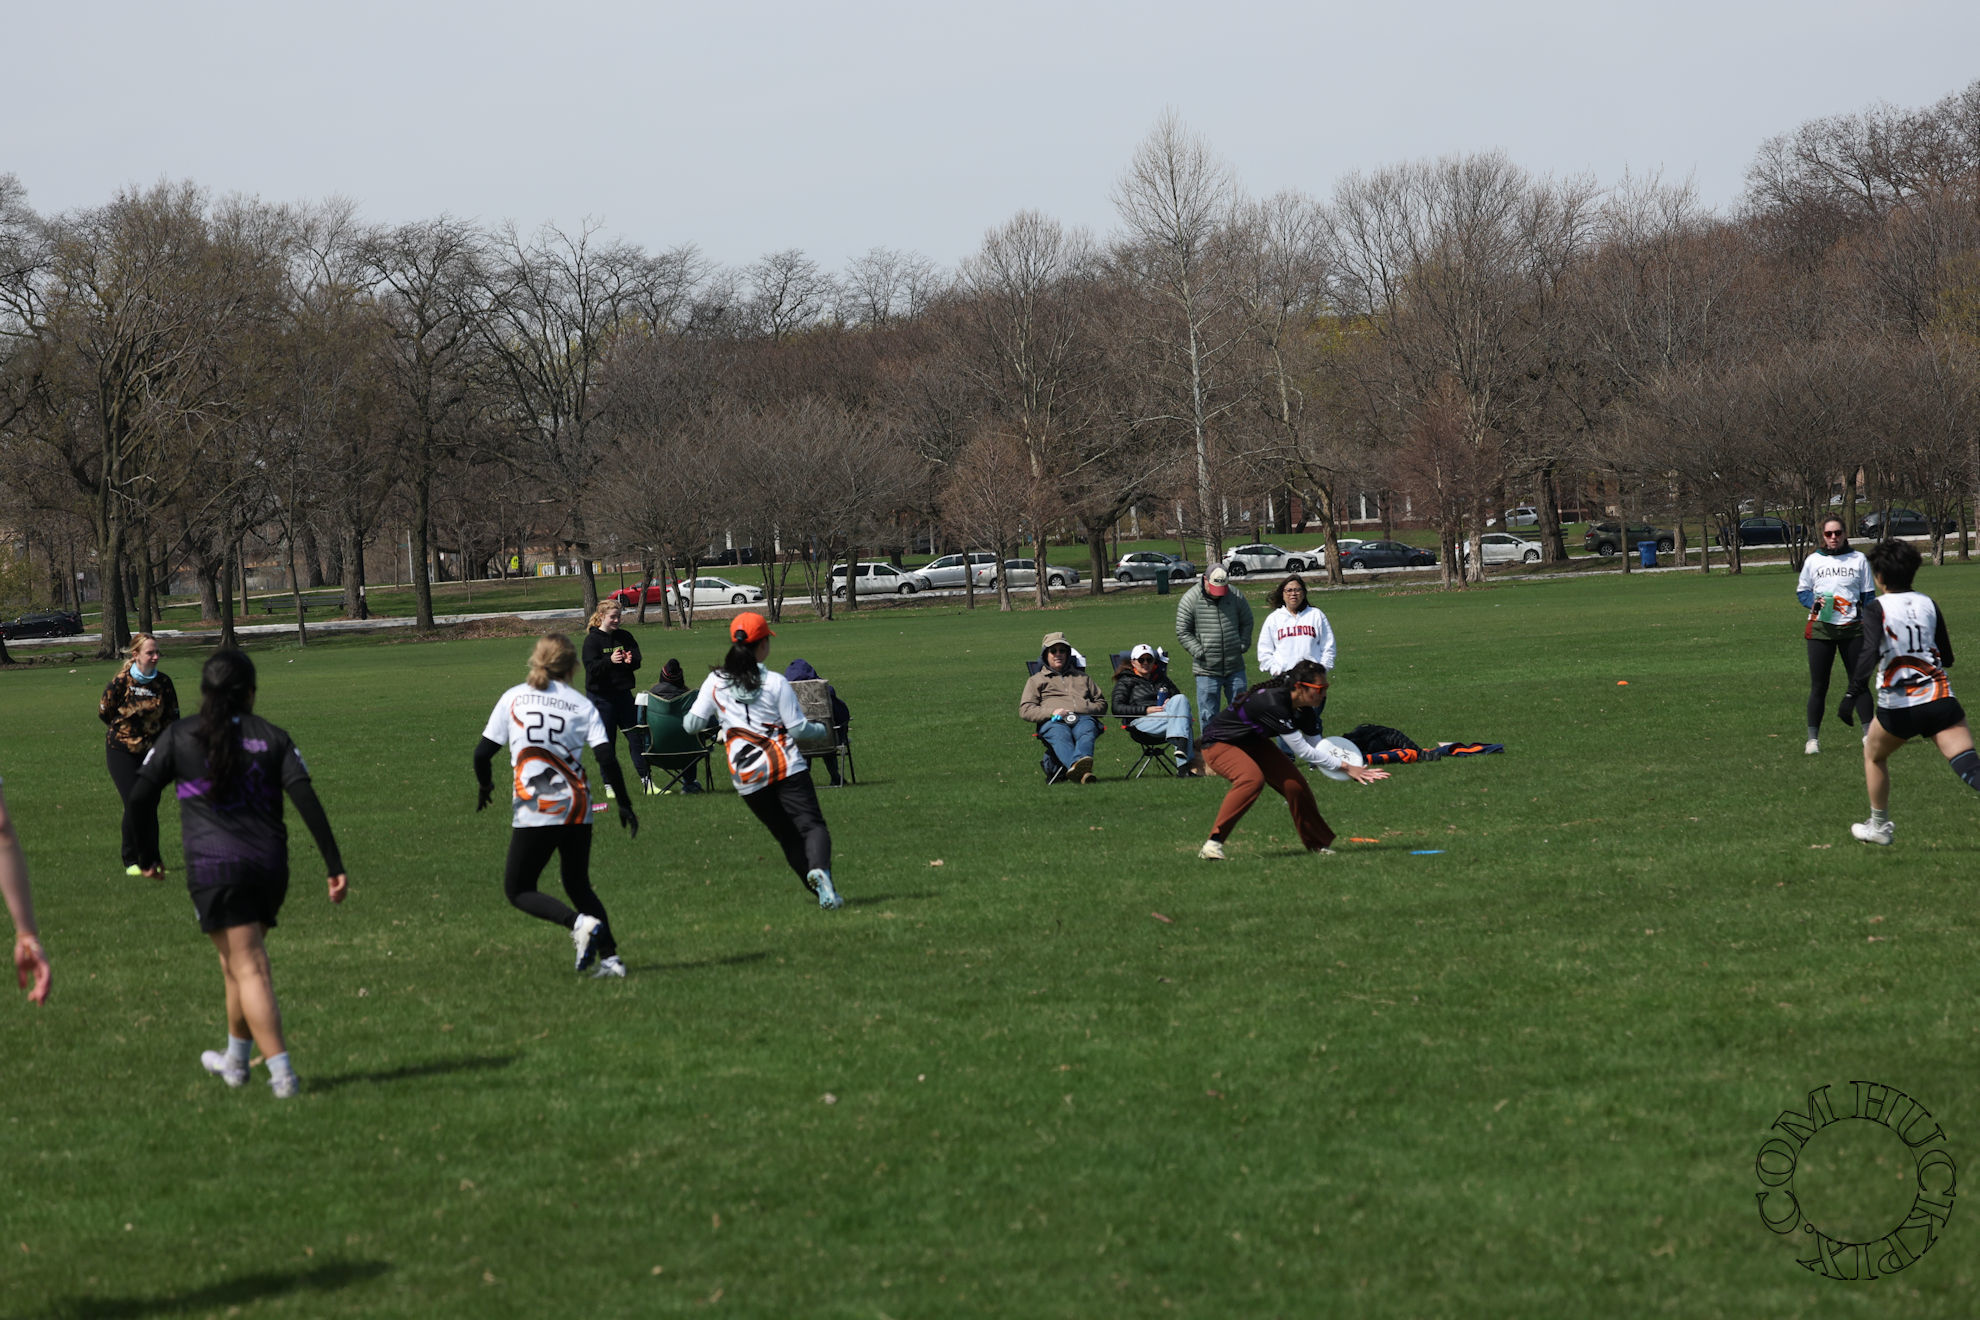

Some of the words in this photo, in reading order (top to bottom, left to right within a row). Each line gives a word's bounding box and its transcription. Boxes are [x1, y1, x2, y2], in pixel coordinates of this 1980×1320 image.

[1816, 567, 1855, 578] MAMBA
[1277, 625, 1317, 641] ILLINOIS
[1905, 625, 1924, 653] 11
[515, 694, 580, 714] COTTURONE
[526, 711, 569, 749] 22
